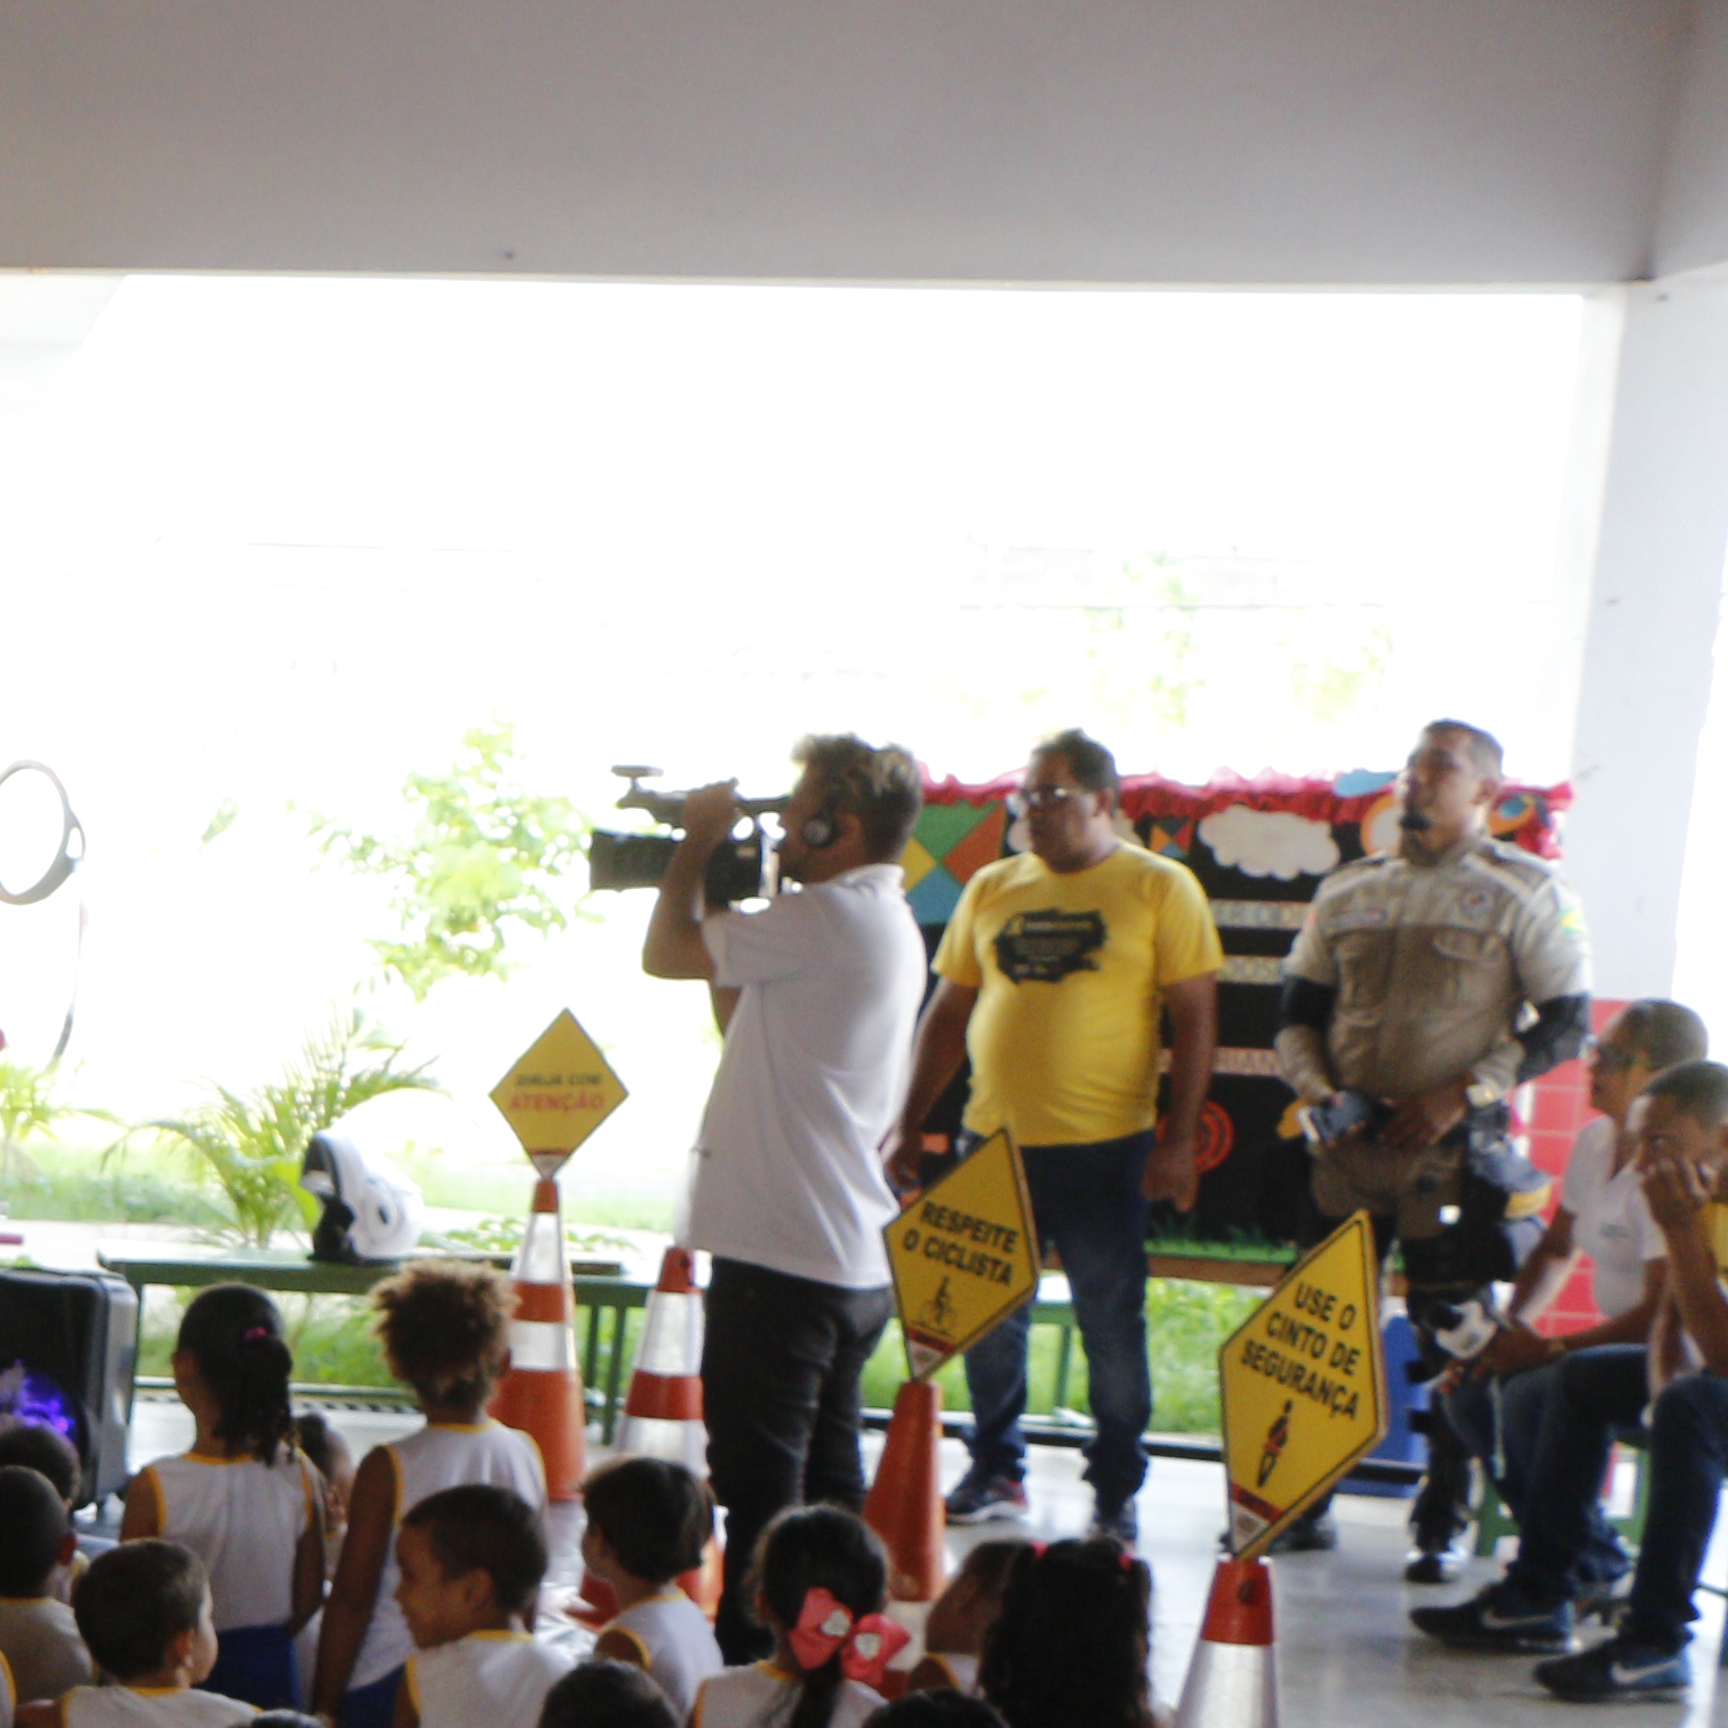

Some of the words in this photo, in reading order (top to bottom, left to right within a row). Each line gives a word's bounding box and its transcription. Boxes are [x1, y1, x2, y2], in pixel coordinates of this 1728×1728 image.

[508, 1092, 605, 1114] ATENÇÃO
[920, 1200, 1019, 1253] RESPEITE
[903, 1228, 920, 1251] O
[924, 1235, 1014, 1288] CICLISTA
[1294, 1281, 1338, 1322] USE
[1339, 1303, 1357, 1331] O
[1267, 1311, 1327, 1360] CINTO
[1330, 1342, 1361, 1376] DE
[1241, 1338, 1360, 1421] SEGURANÇA
